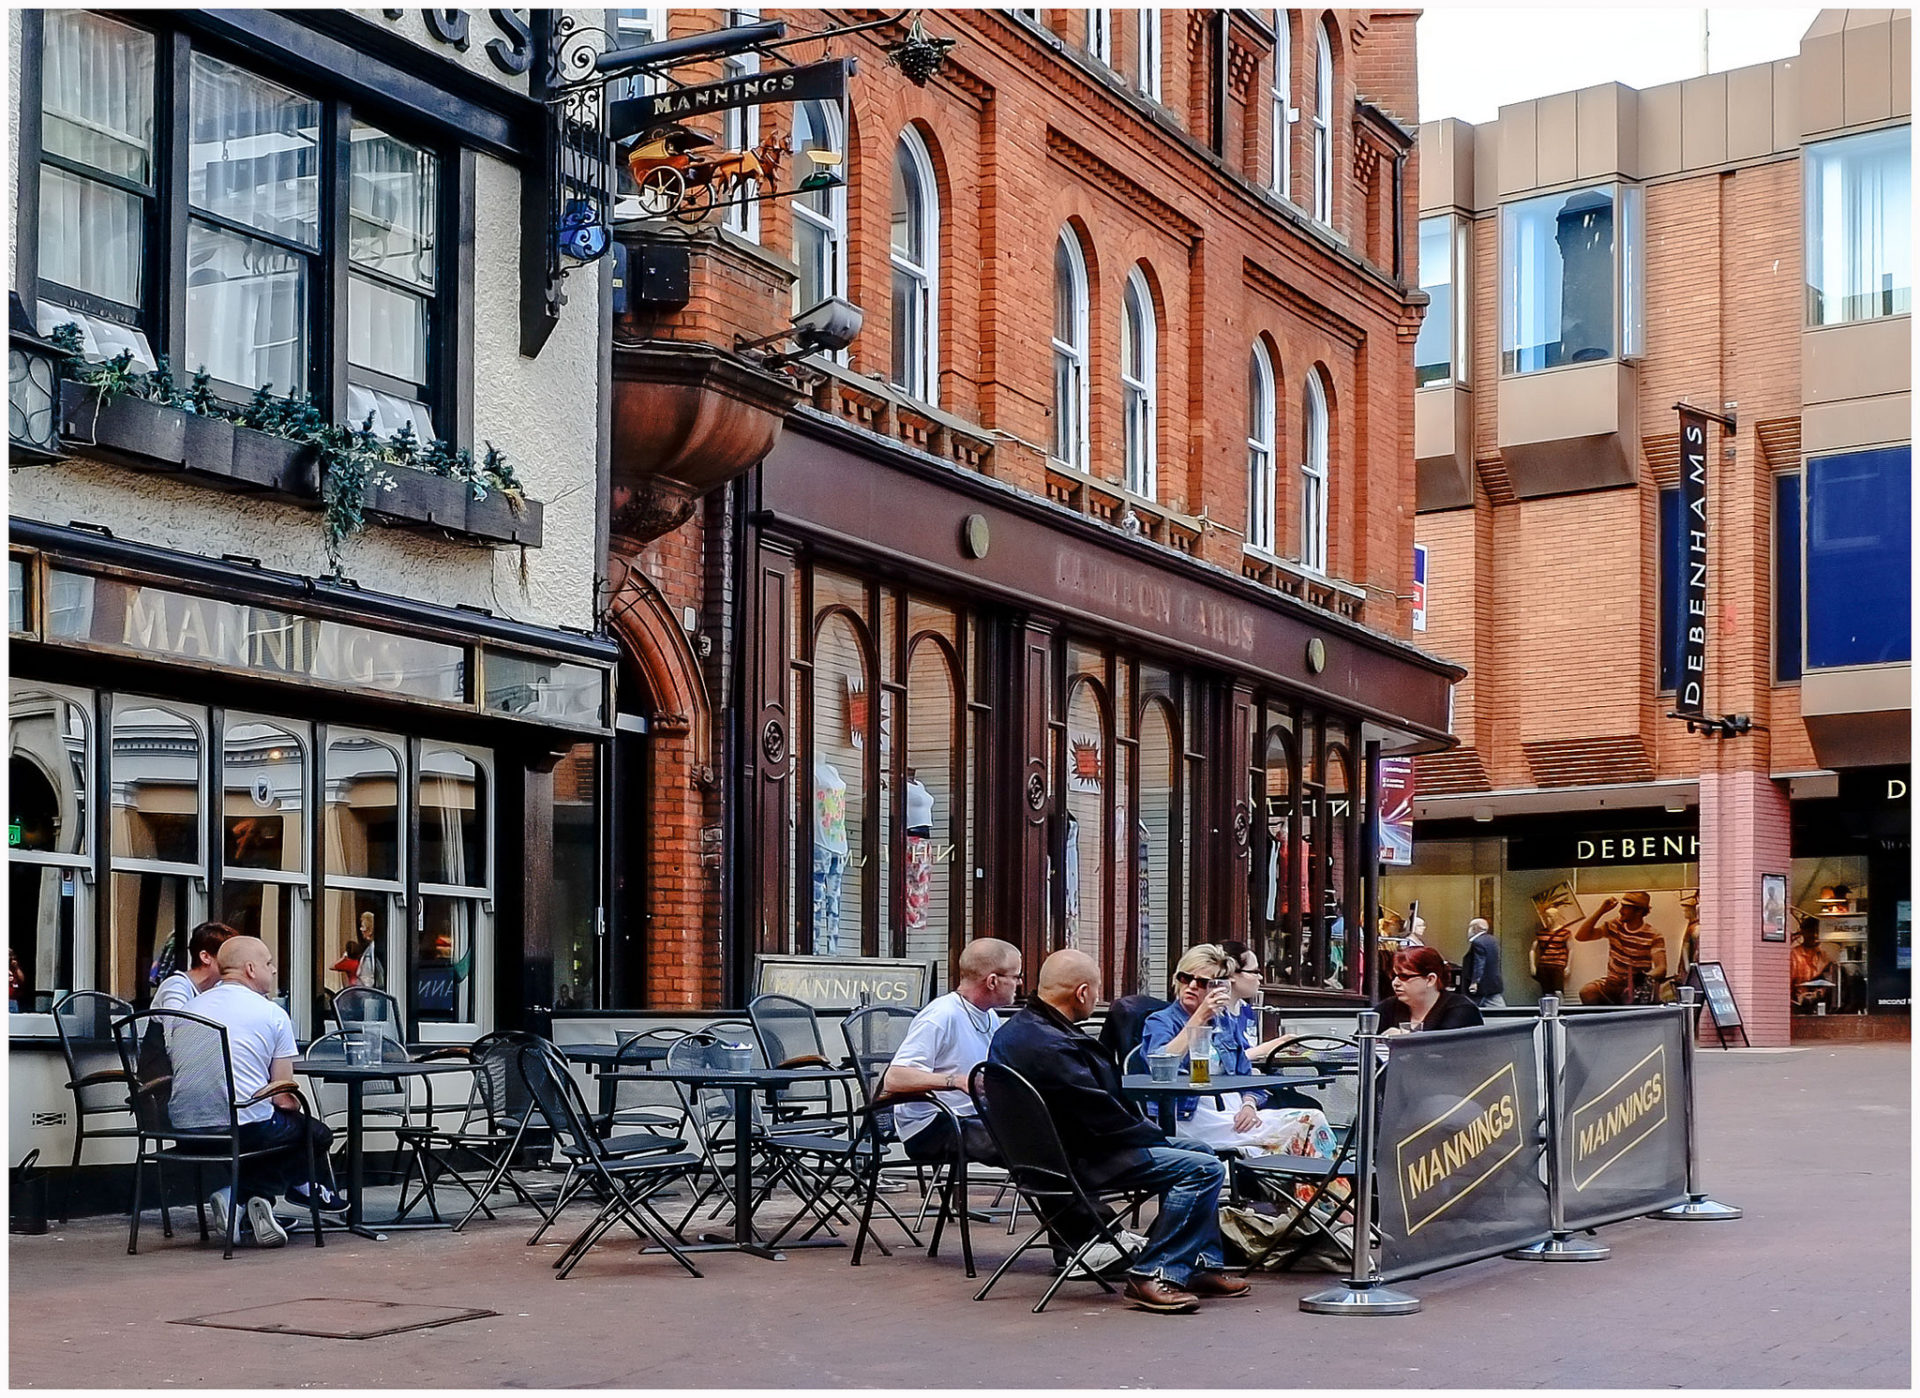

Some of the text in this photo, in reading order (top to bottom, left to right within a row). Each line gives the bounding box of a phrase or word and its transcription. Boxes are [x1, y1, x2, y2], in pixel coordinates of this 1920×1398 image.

[654, 74, 794, 116] MANNINGS
[1684, 425, 1706, 706] DEBENHAMS
[122, 587, 403, 689] MANNINGS
[1407, 1095, 1514, 1199] MANNINGS
[1578, 1073, 1662, 1162] MANNINGS
